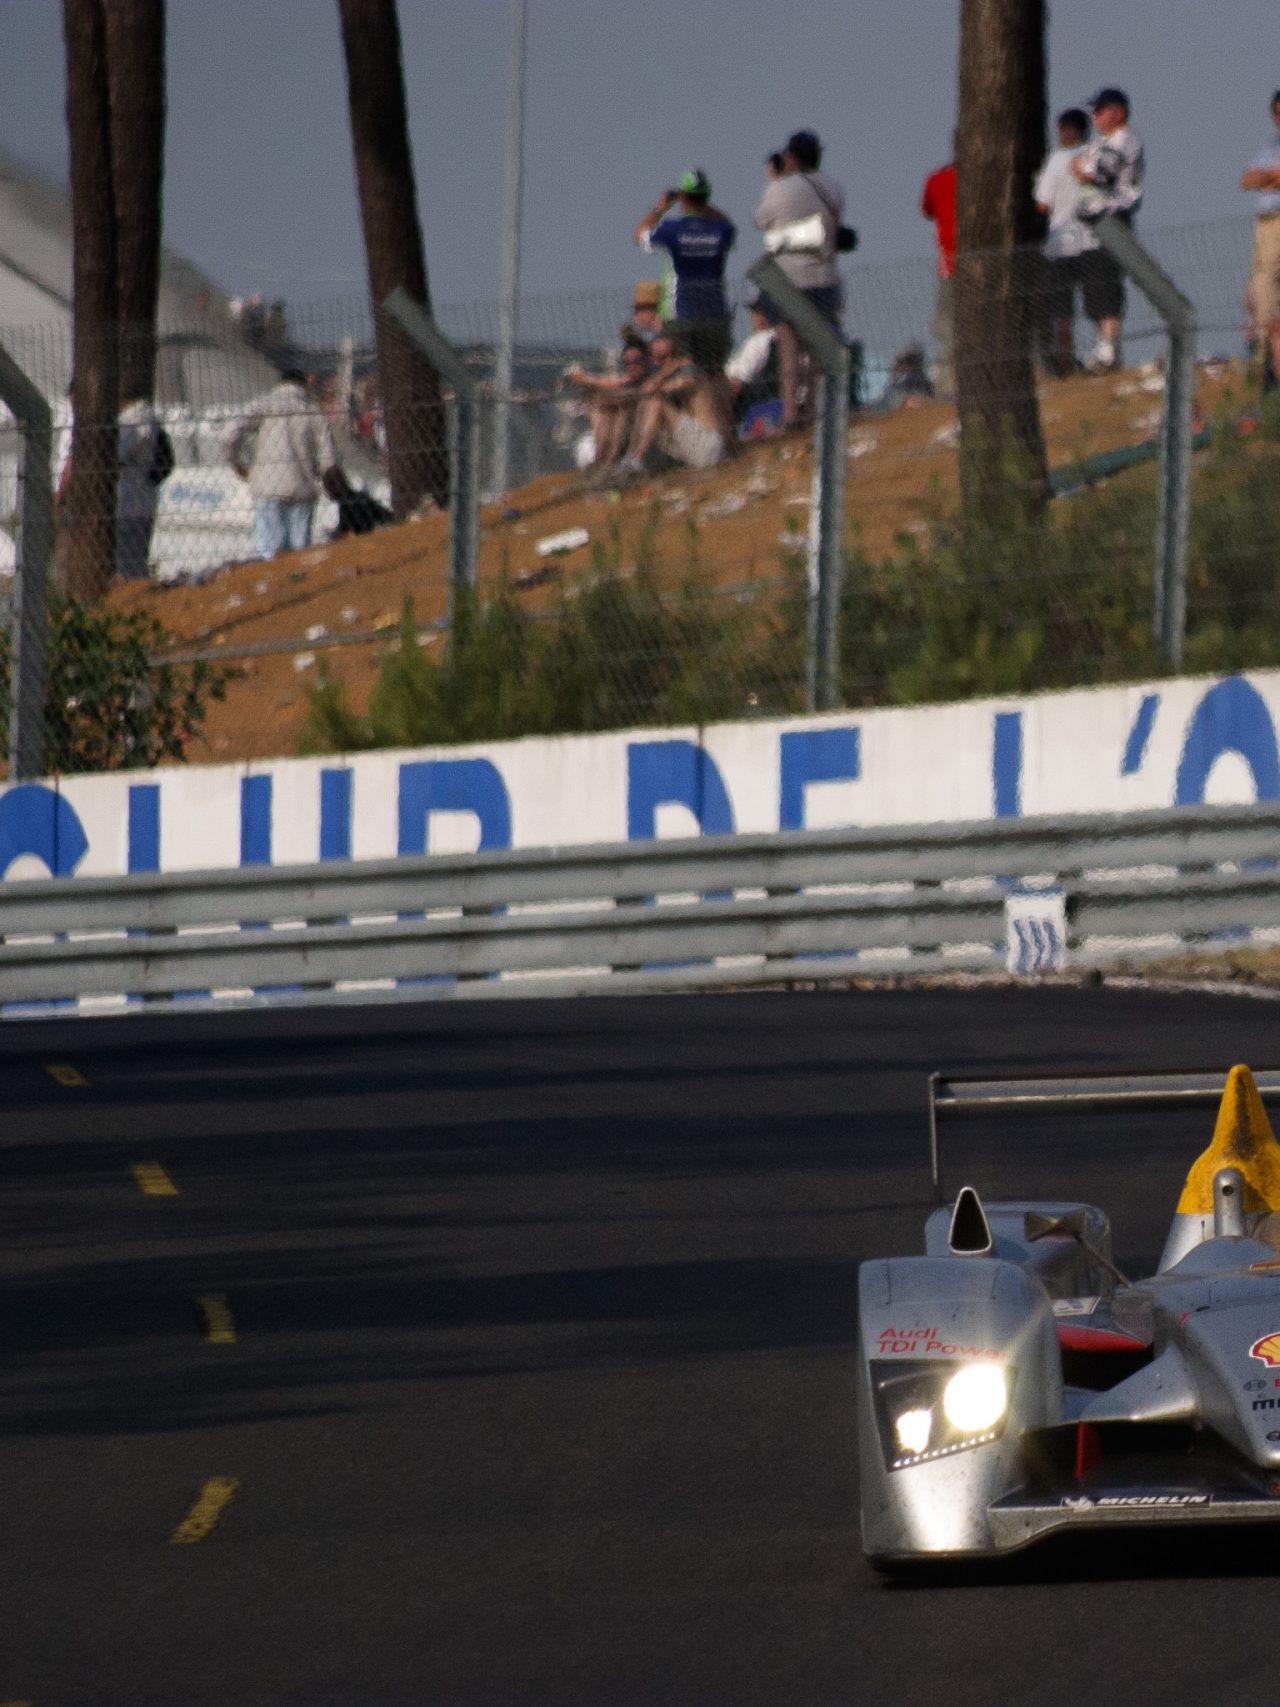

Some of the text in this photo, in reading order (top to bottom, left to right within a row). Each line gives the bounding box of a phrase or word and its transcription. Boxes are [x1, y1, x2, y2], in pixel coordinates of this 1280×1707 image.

[878, 1327, 938, 1340] Audi
[877, 1341, 917, 1353] TDI
[1097, 1495, 1207, 1506] MICHELIN
